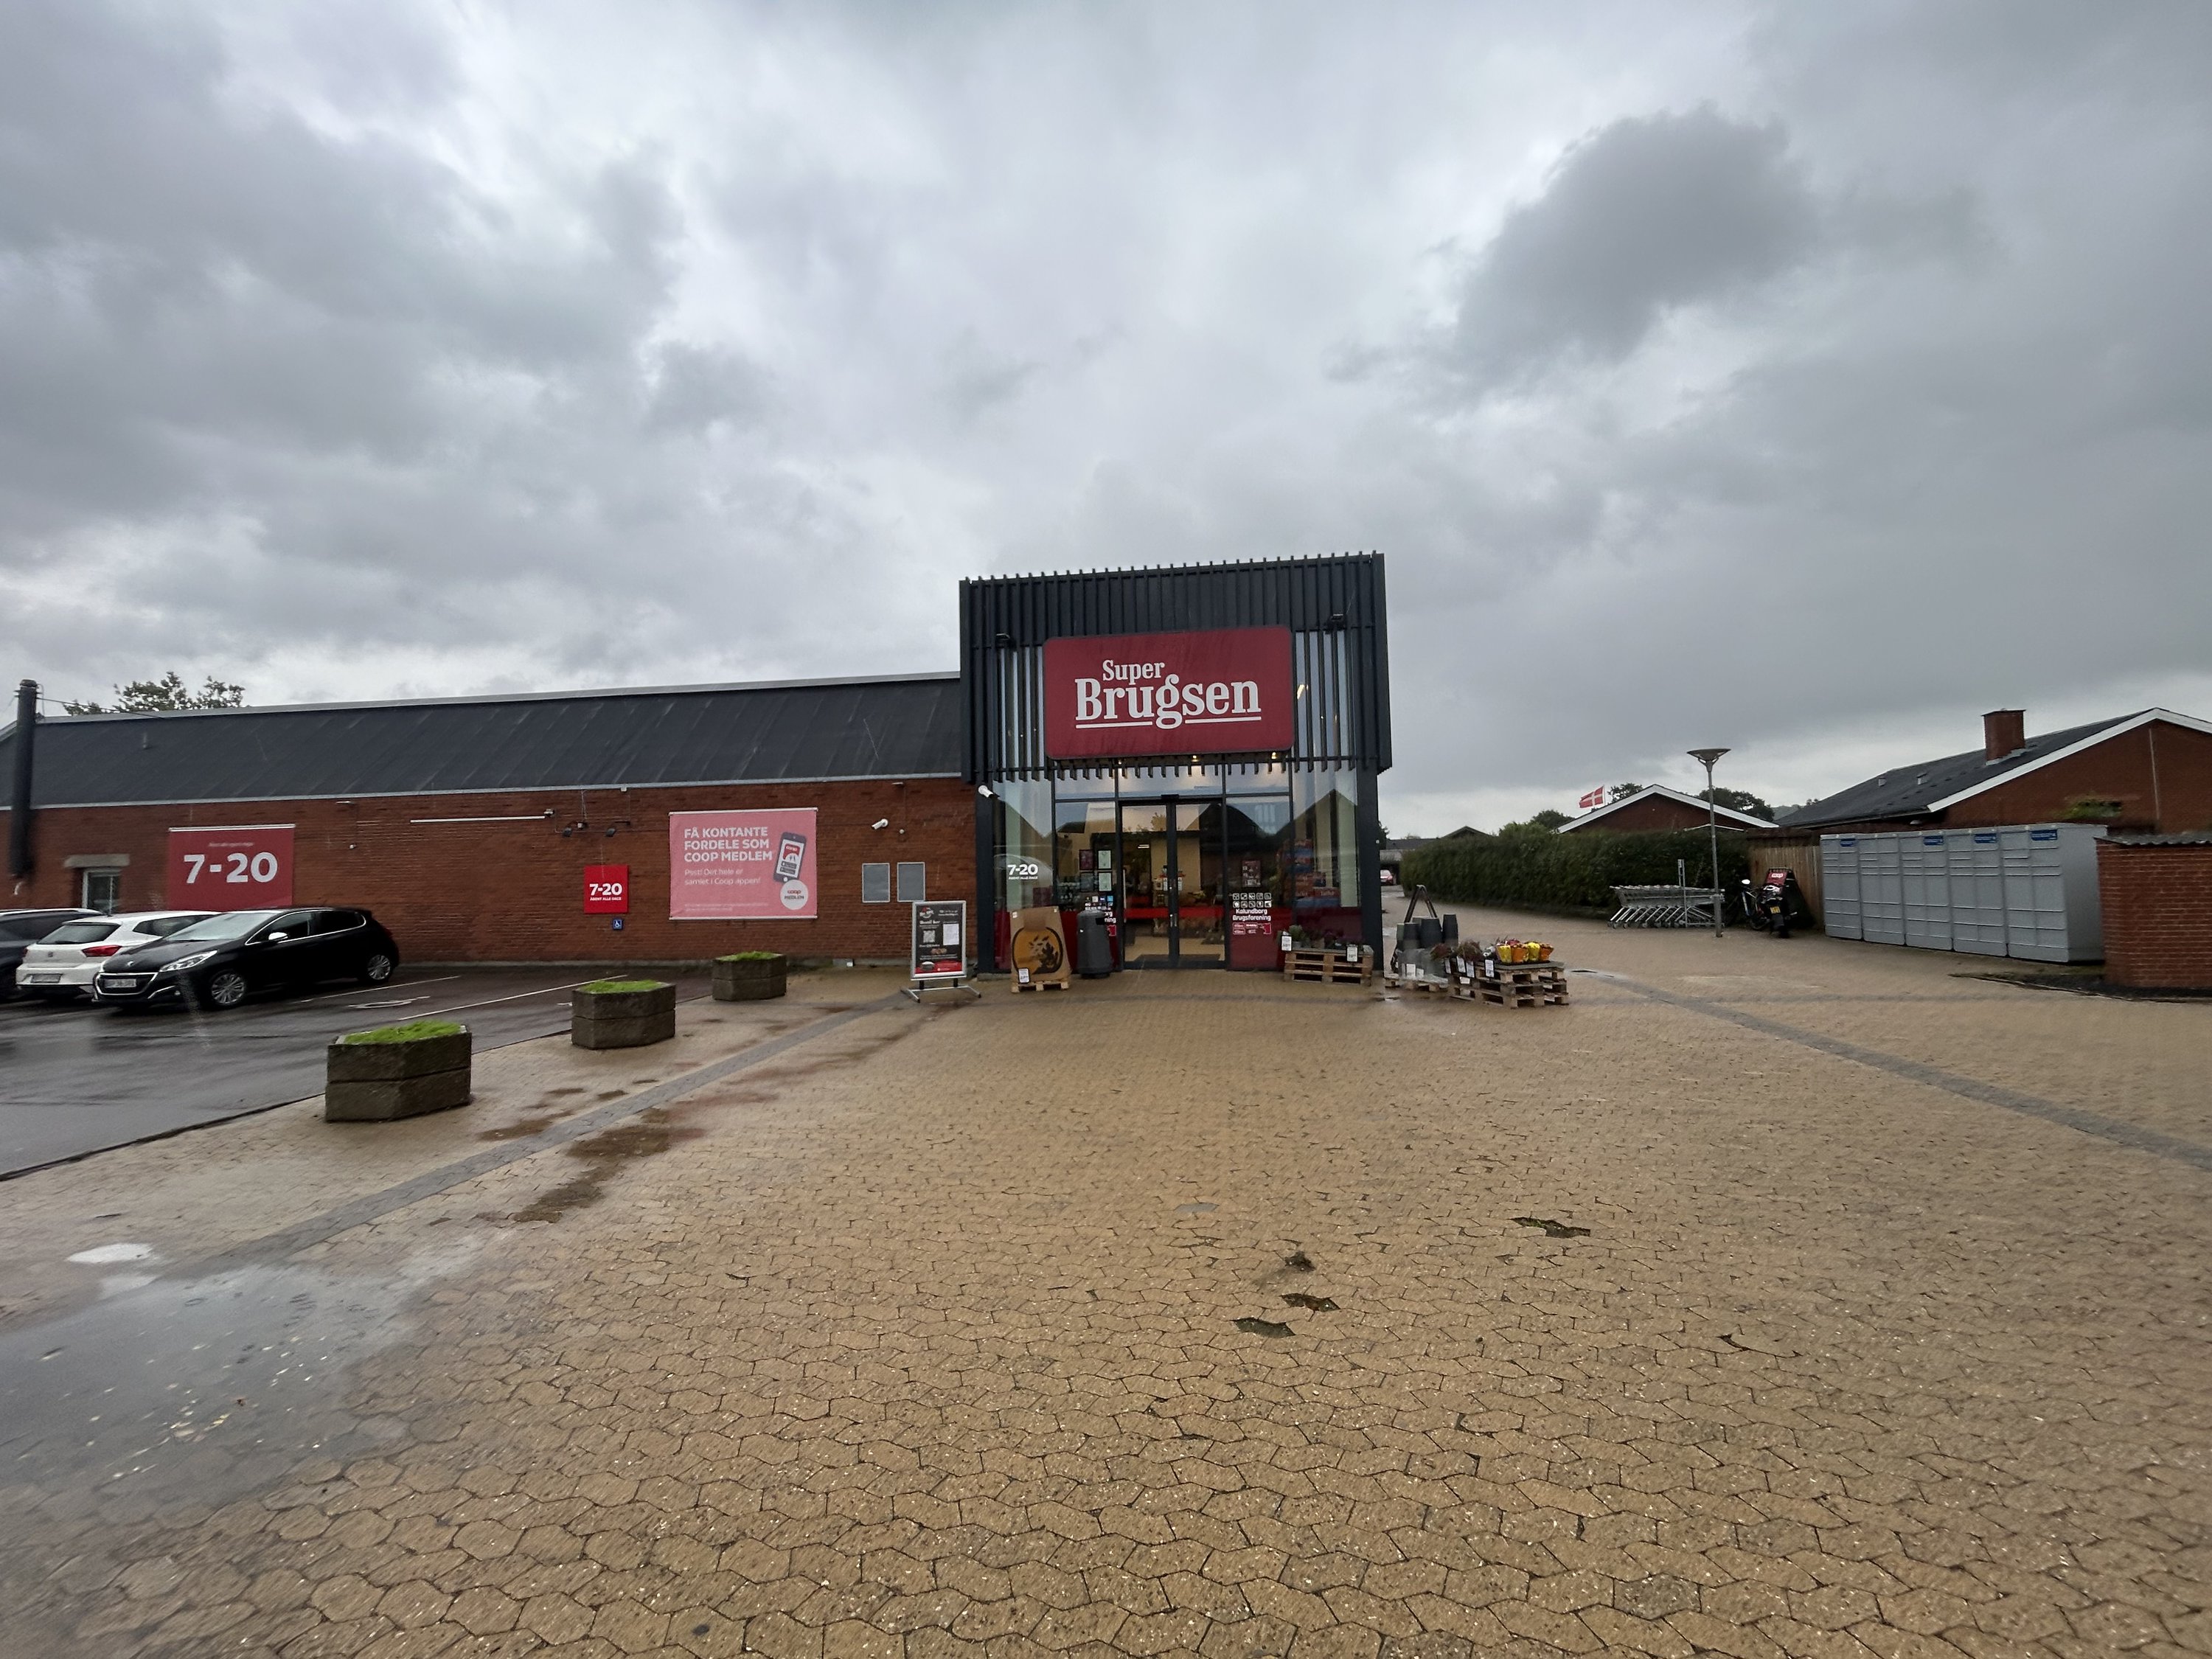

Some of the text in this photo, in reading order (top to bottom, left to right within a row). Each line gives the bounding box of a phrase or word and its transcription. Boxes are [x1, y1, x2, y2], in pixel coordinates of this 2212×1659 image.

[1102, 659, 1165, 686] Super
[1074, 673, 1262, 729] Brugsen
[684, 827, 768, 838] FÅ KONTANTE
[684, 838, 770, 850] FORDELE SOM
[684, 850, 773, 863] COOP MEDLEM
[184, 852, 278, 884] 7-20
[1007, 863, 1038, 875] 7-20
[714, 877, 734, 886] Coop
[589, 883, 622, 896] 7-20
